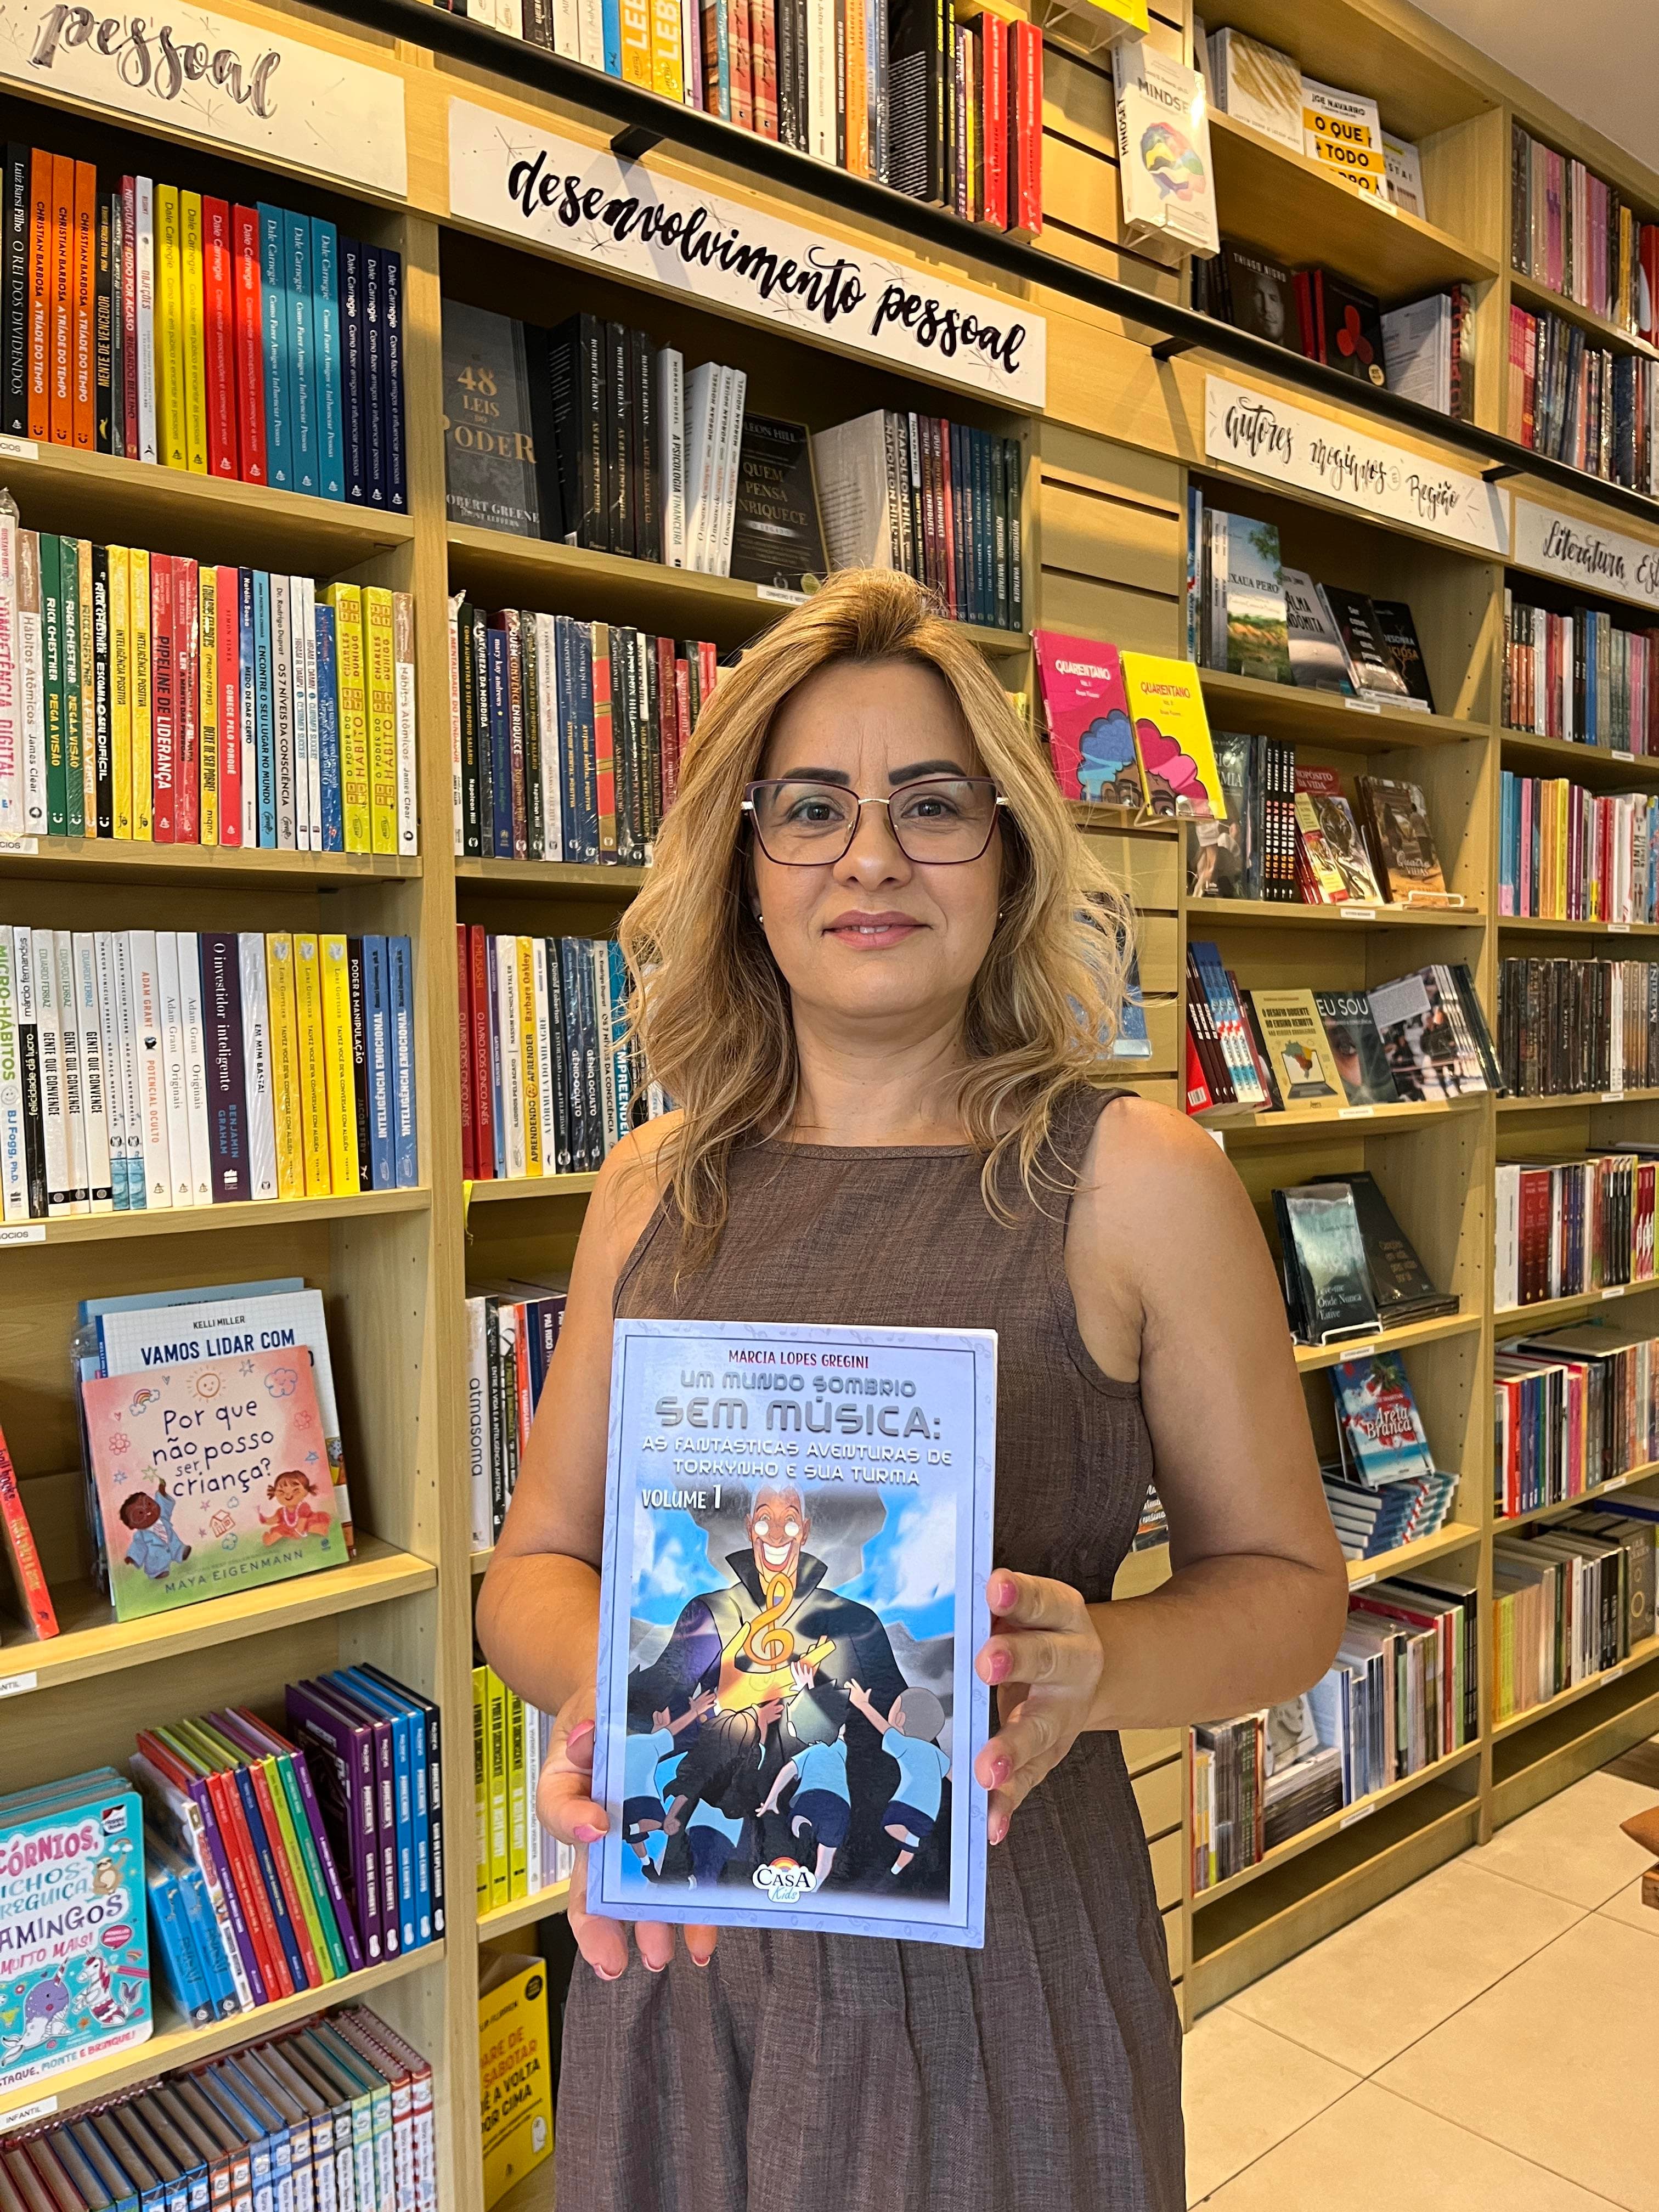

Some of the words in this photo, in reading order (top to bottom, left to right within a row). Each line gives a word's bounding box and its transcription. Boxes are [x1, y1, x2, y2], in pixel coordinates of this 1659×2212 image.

[1137, 77, 1190, 114] MINDSE
[1327, 98, 1365, 116] NAVARRO
[1116, 99, 1129, 156] MINDSET
[1315, 116, 1325, 131] O
[1330, 122, 1363, 142] QUE
[1326, 143, 1369, 167] TODO
[13, 162, 24, 183] Luiz
[13, 183, 24, 207] Barsi
[13, 208, 24, 232] Filho
[35, 201, 45, 251] CHRISTIAN
[10, 240, 24, 252] O
[10, 255, 24, 275] REI
[34, 253, 44, 297] BARBOSA
[345, 253, 356, 274] Dale
[509, 150, 866, 323] desenvolvimento
[871, 284, 1026, 374] pessoal
[10, 279, 24, 306] DOS
[345, 275, 358, 317] Carnegie
[33, 310, 45, 342] TRÍADE
[348, 324, 357, 347] Como
[10, 311, 23, 395] DIVIDENDOS
[33, 344, 43, 359] DO
[348, 348, 358, 368] fazer
[33, 360, 42, 393] TEMPO
[457, 366, 498, 396] 48
[463, 395, 500, 417] LEIS
[350, 444, 361, 476] pessoas
[671, 442, 681, 492] PSICOLOGIA
[743, 461, 785, 483] QUEM
[745, 481, 788, 503] PENSA
[492, 504, 540, 523] GREENE
[671, 494, 682, 545] FINANCEIRA
[45, 597, 56, 623] RICK
[22, 616, 36, 663] Hábitos
[46, 625, 58, 681] CHESTHER
[156, 635, 171, 693] PIPELINE
[257, 645, 267, 692] ENCONTRE
[1055, 659, 1111, 680] QUARENTANO
[24, 667, 38, 725] Atômicos
[156, 697, 171, 713] DE
[1141, 681, 1190, 698] QUARENTANO
[48, 693, 59, 721] PEGA
[259, 703, 268, 721] SEU
[27, 733, 38, 765] James
[49, 733, 62, 766] VISÃO
[154, 715, 172, 789] LIDERANÇA
[259, 723, 269, 753] LUGAR
[261, 755, 269, 769] NO
[28, 768, 38, 792] Clear
[261, 770, 270, 804] MUNDO
[17, 937, 30, 983] fernandes
[212, 942, 225, 953] O
[348, 958, 360, 990] PODER
[521, 951, 533, 984] Oakley
[139, 971, 150, 996] ADAM
[213, 956, 229, 1019] investidor
[20, 985, 32, 1017] márcio
[140, 999, 153, 1028] GRANT
[522, 986, 533, 1022] Barbara
[1317, 998, 1336, 1017] EU
[1338, 997, 1369, 1017] SOU
[24, 1033, 35, 1057] lucro
[84, 1031, 99, 1054] GENTE
[349, 999, 365, 1064] MANIPULAÇÃO
[25, 1058, 36, 1071] dá
[86, 1057, 100, 1073] QUE
[213, 1023, 232, 1092] inteligente
[524, 1033, 536, 1082] APRENDER
[26, 1071, 38, 1116] felicidade
[87, 1074, 103, 1114] CONVENCE
[145, 1059, 158, 1107] POTENCIAL
[148, 1109, 160, 1143] OCULTO
[217, 1109, 228, 1154] GRAHAM
[227, 1104, 240, 1159] BENJAMIN
[527, 1099, 539, 1163] APRENDENDO
[193, 1320, 216, 1329] KELLI
[217, 1316, 246, 1328] MILLER
[140, 1341, 200, 1365] VAMOS
[206, 1334, 255, 1357] LIDAR
[261, 1329, 295, 1350] COM
[729, 1348, 776, 1364] MÁRCIA
[780, 1352, 817, 1366] LOPES
[821, 1353, 869, 1369] GREGINI
[680, 1370, 714, 1389] UM
[722, 1370, 805, 1392] MUNDO
[812, 1373, 916, 1398] SOMBRIO
[163, 1409, 205, 1435] Por
[216, 1400, 257, 1430] que
[468, 1377, 484, 1476] atmasoma
[655, 1395, 748, 1430] SEM
[766, 1395, 941, 1440] MÚSICA:
[1367, 1419, 1412, 1440] Branca
[1375, 1404, 1409, 1427] Areia
[153, 1438, 197, 1465] não
[204, 1430, 274, 1470] posso
[642, 1436, 668, 1451] AS
[675, 1435, 799, 1456] FANTÁSTICAS
[806, 1441, 921, 1463] AVENTURAS
[927, 1449, 952, 1465] DE
[173, 1458, 272, 1497] criança?
[176, 1460, 200, 1476] ser
[673, 1458, 778, 1477] TORKYNHO
[786, 1464, 797, 1477] E
[804, 1465, 844, 1481] SUA
[851, 1468, 920, 1486] TURMA
[641, 1488, 707, 1509] VOLUME
[713, 1484, 723, 1509] 1
[165, 1575, 207, 1594] MAYA
[212, 1550, 303, 1581] EIGENMANN
[772, 1887, 797, 1900] Kids
[1, 1948, 47, 1975] MUITO
[52, 1932, 94, 1958] MAIS!
[41, 2052, 78, 2072] MONTE
[88, 2030, 136, 2055] BRINQUE!
[6, 2107, 41, 2123] INFANTIL
